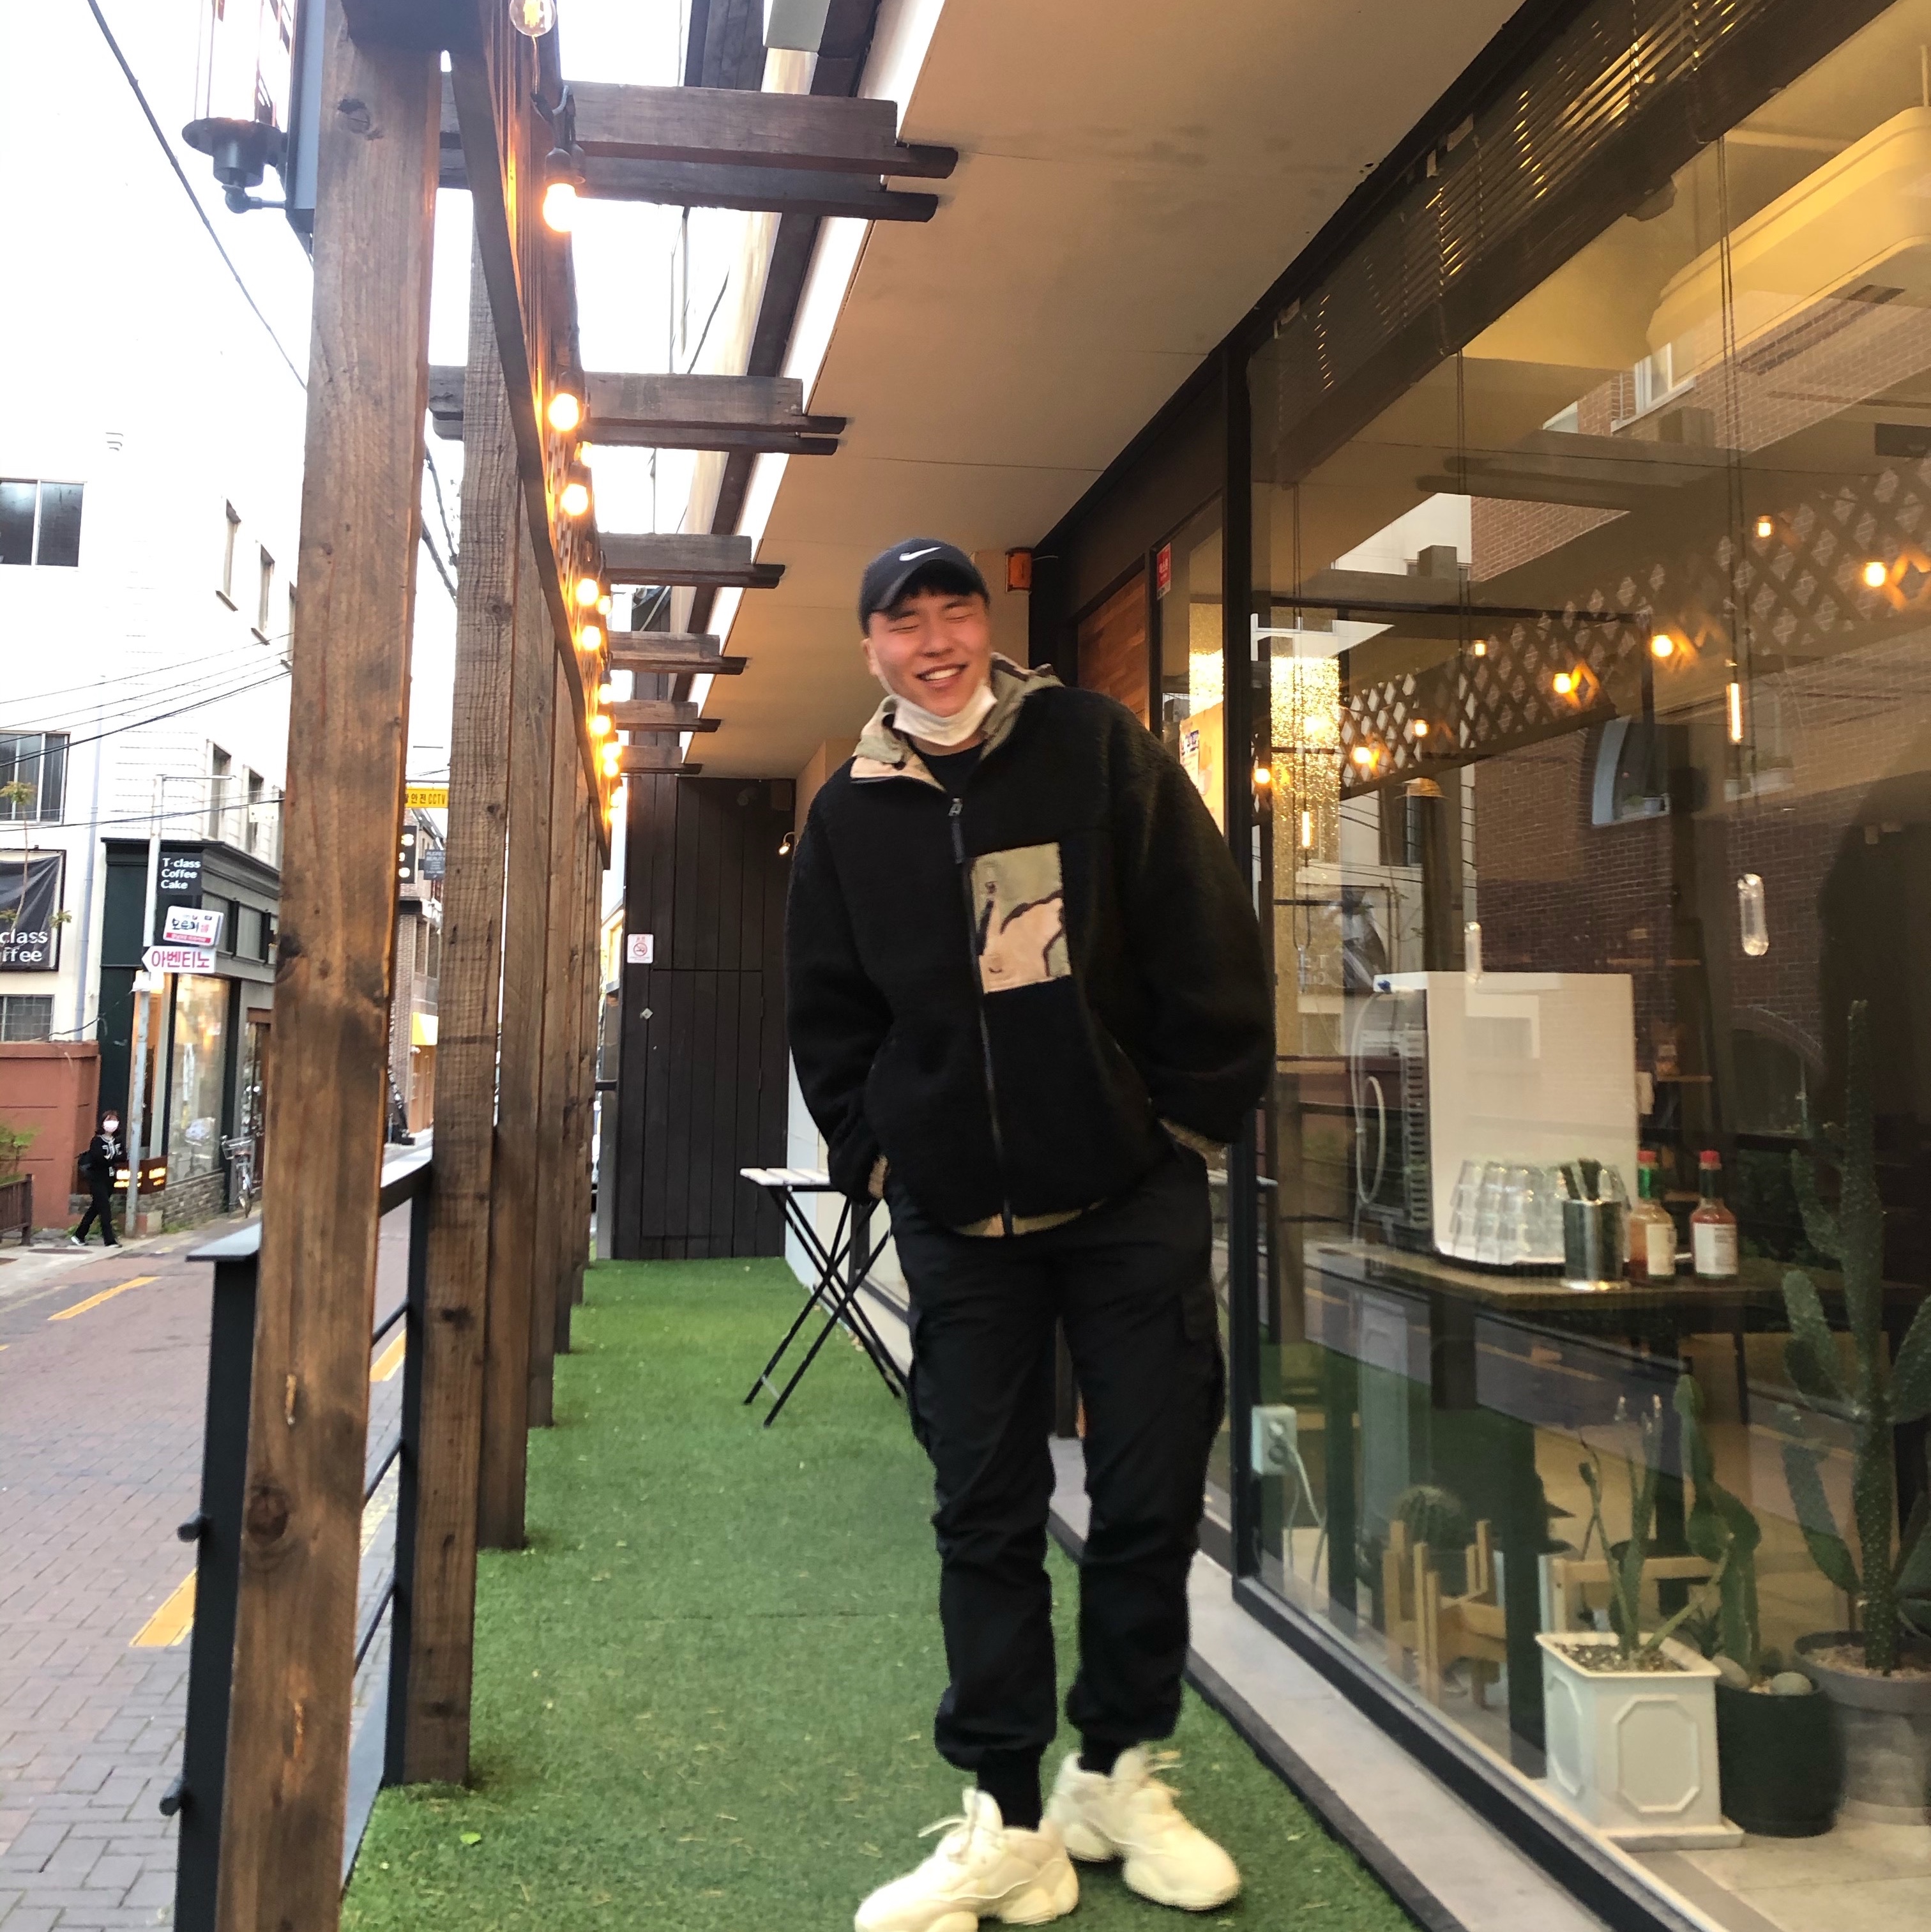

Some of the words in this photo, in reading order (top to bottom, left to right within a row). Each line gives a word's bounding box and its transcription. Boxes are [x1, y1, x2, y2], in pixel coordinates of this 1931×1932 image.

[162, 869, 197, 878] Coffee
[161, 879, 188, 889] Cake
[0, 947, 42, 962] ffee
[151, 950, 210, 968] 아벤티노
